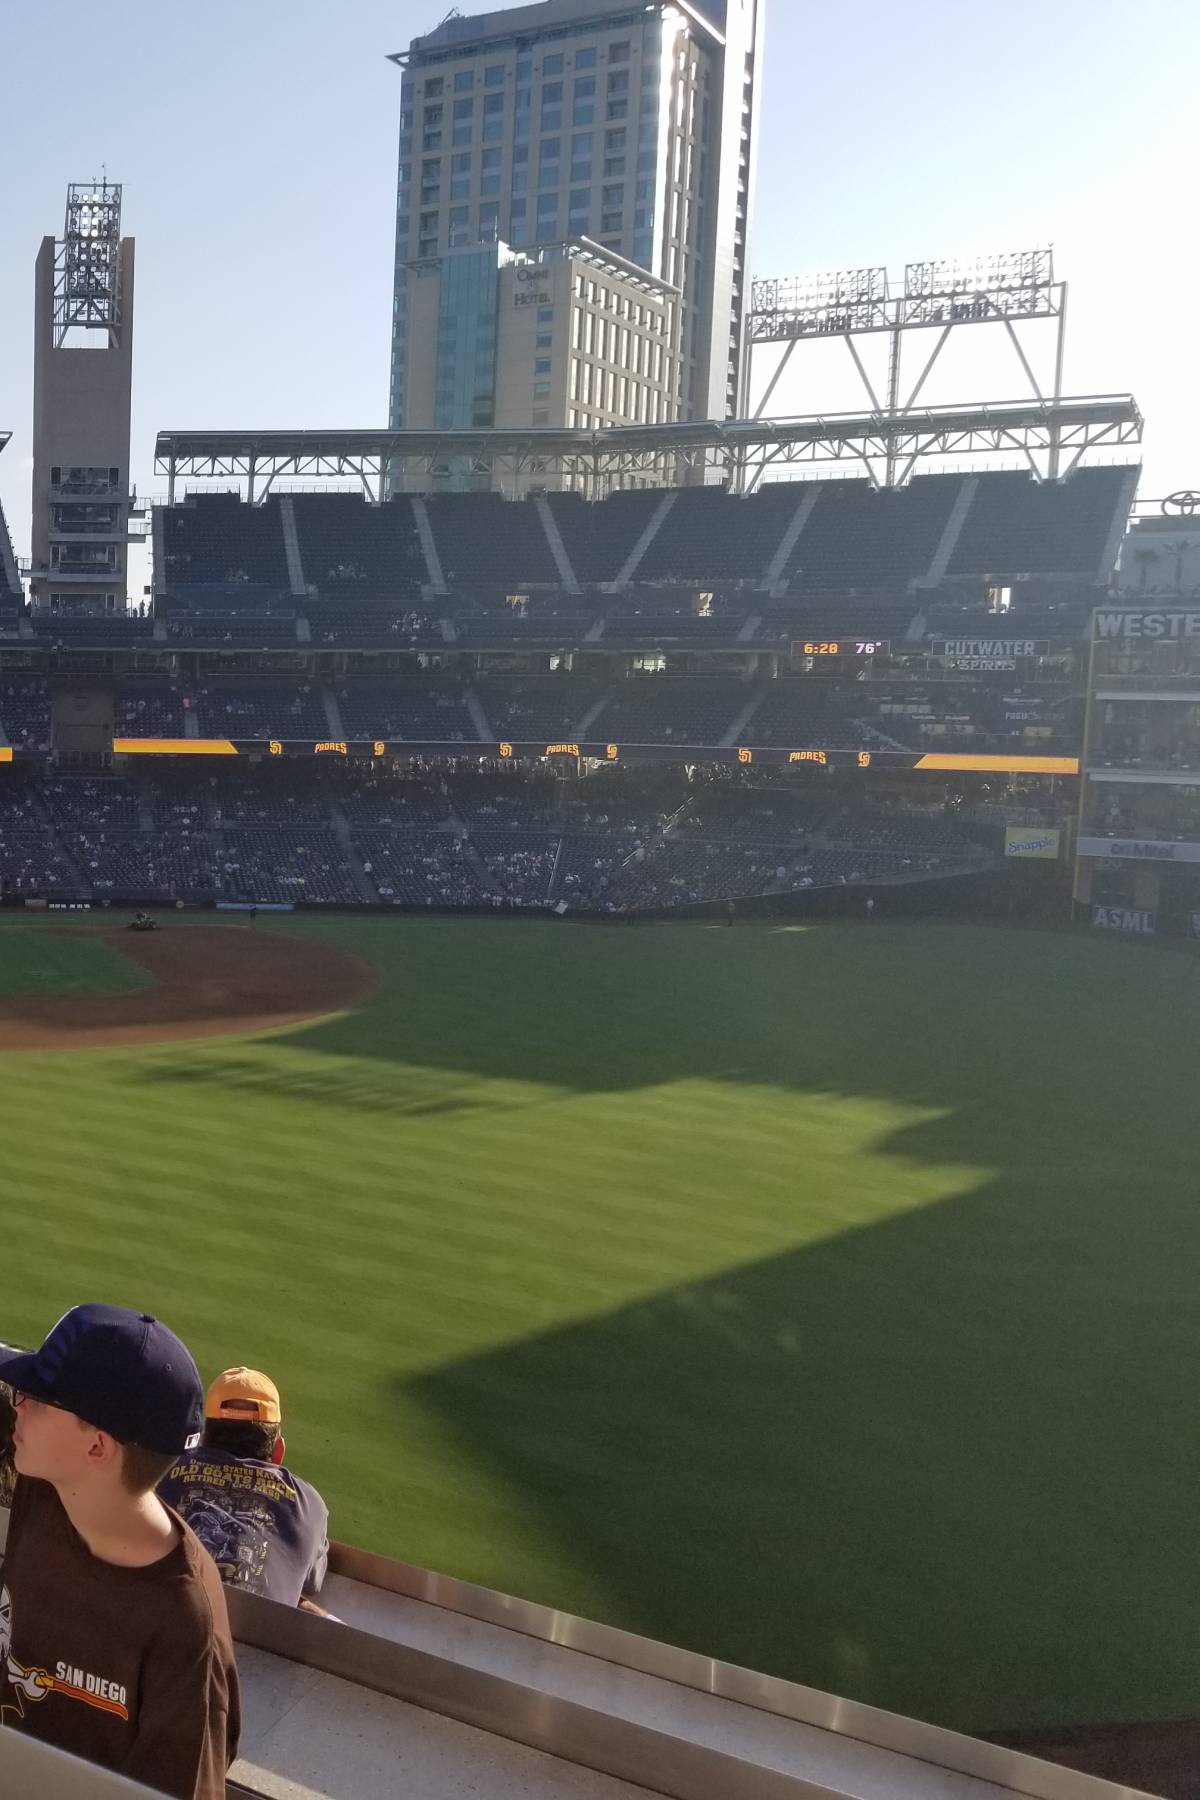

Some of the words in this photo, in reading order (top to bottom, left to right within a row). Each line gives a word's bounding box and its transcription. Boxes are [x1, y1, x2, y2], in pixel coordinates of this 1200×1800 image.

[944, 641, 1036, 656] CUTWATER
[314, 742, 347, 754] PADRES
[546, 743, 580, 756] PADRES
[788, 751, 827, 765] PADRES
[1093, 907, 1155, 934] ASML
[170, 1464, 199, 1480] OLD
[203, 1466, 253, 1484] GOATS
[183, 1474, 226, 1487] RETIRED
[55, 1661, 84, 1689] SAN
[85, 1672, 127, 1705] DIEGO
